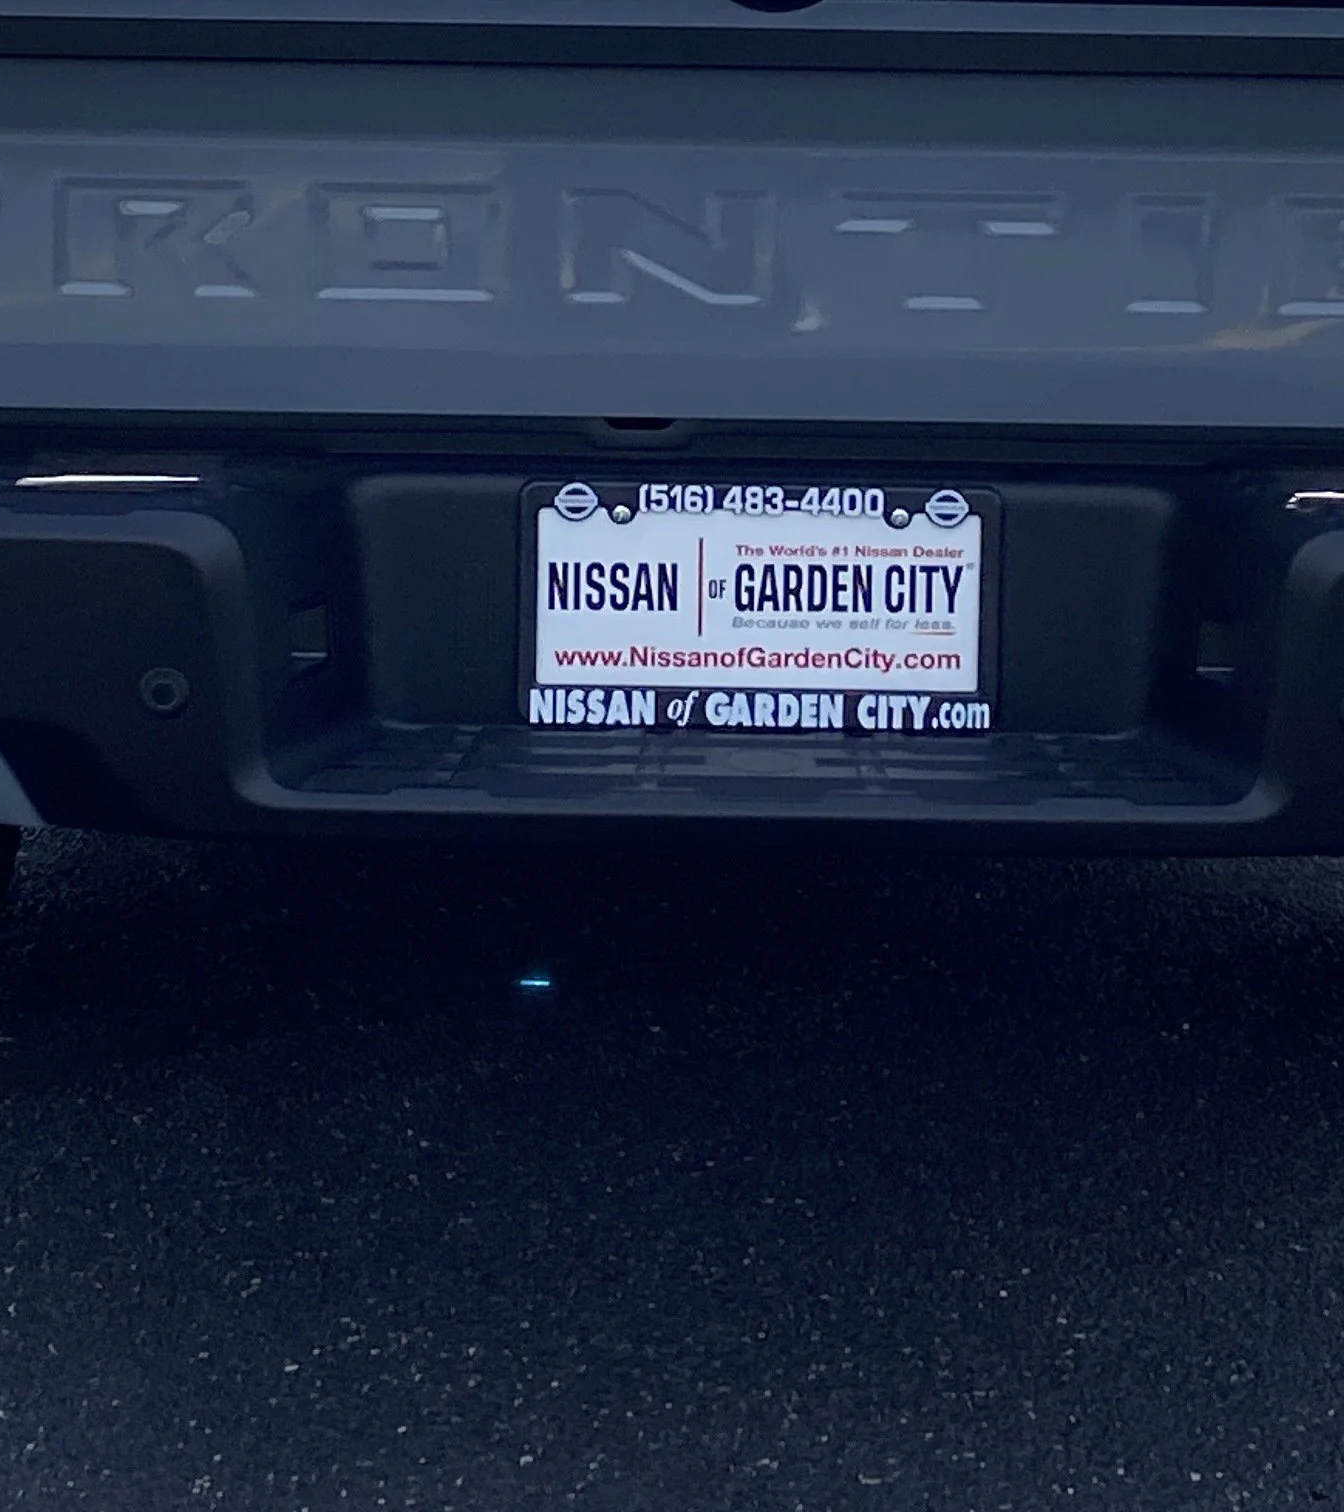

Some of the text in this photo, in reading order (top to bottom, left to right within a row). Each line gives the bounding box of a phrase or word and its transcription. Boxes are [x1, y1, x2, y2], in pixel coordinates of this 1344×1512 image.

[639, 485, 885, 518] (516) 483-4400
[735, 545, 964, 559] The World's #1 Nissan Dealer
[548, 562, 964, 613] NISSAN OF GARDEN CITY
[732, 616, 811, 630] Because
[816, 619, 842, 630] we
[849, 617, 880, 630] sell
[885, 618, 909, 630] for
[555, 646, 961, 674] www.NissanofGardenCity.com
[530, 689, 990, 730] NISSAN of GARDEN CITY.com
